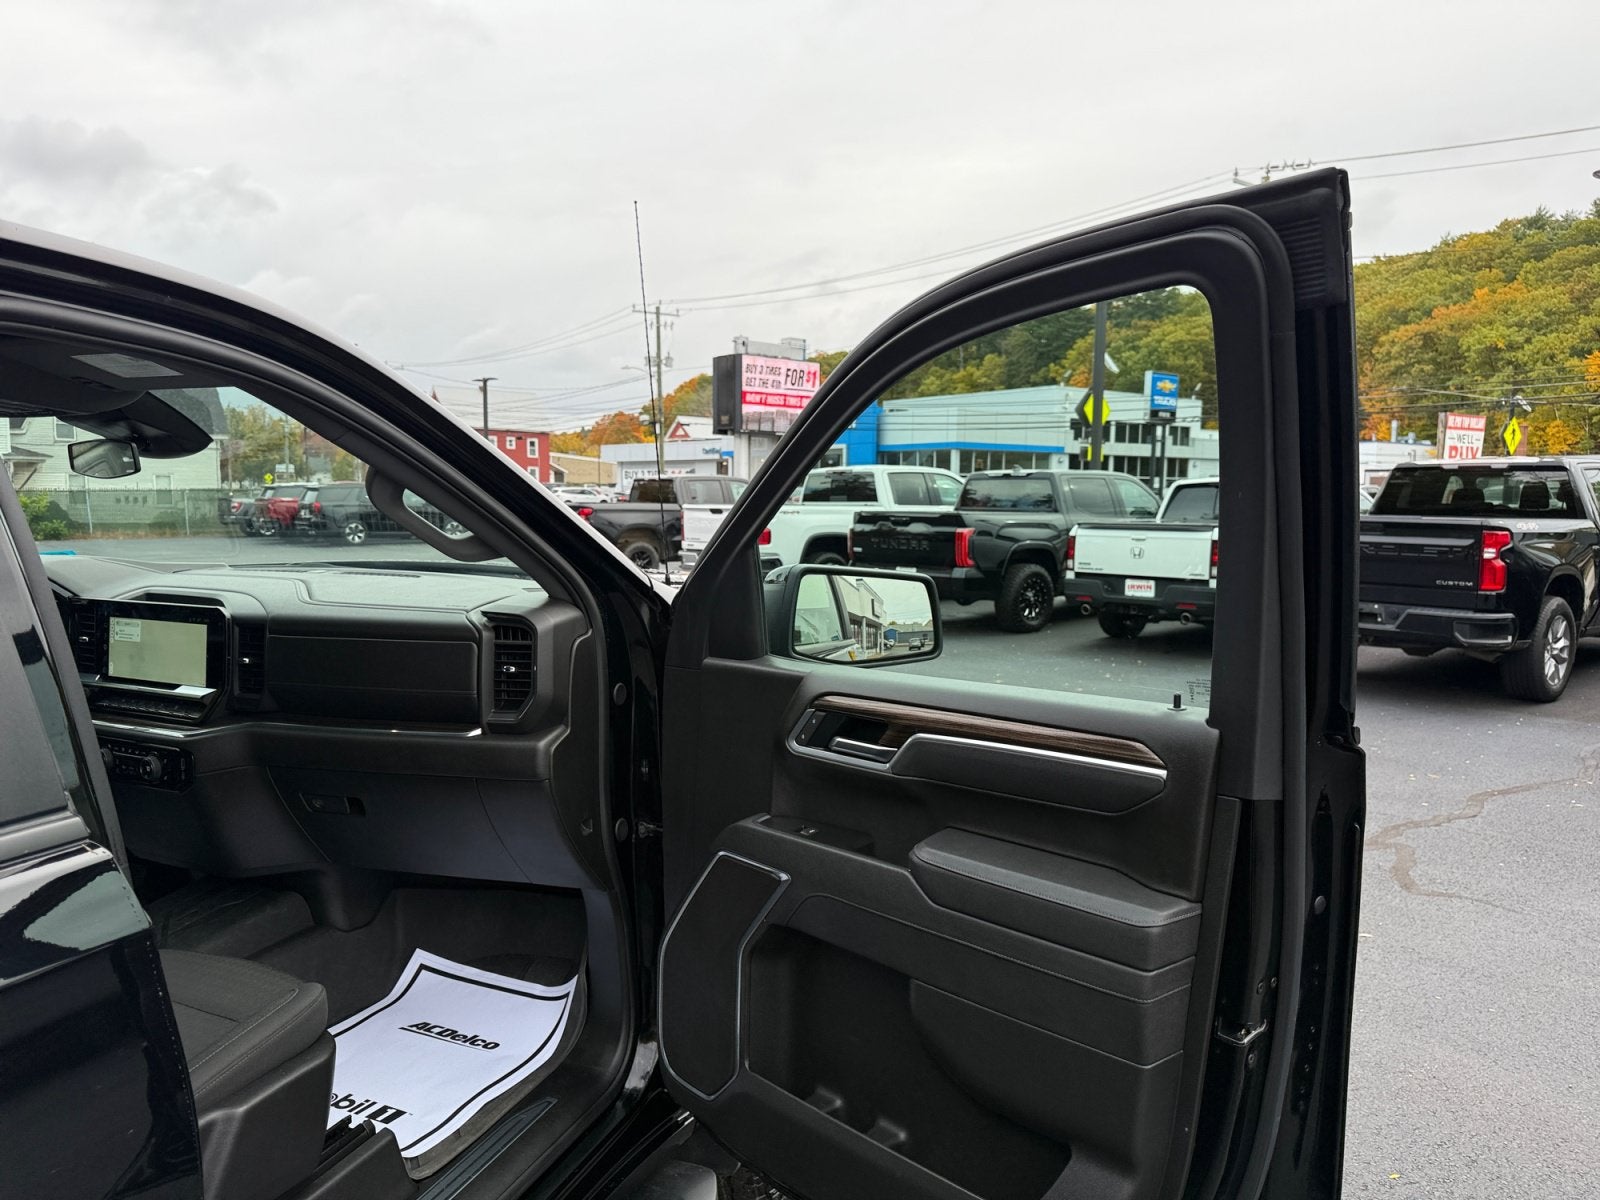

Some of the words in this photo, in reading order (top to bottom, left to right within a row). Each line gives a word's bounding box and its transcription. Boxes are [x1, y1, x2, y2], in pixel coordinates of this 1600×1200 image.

[745, 363, 758, 375] BUY
[765, 366, 782, 377] TIRES
[745, 376, 757, 387] GET
[758, 378, 769, 389] THE
[784, 368, 805, 388] FOR
[805, 370, 817, 388] $1
[1456, 433, 1474, 445] WE'LL
[871, 538, 930, 550] TUNDRA
[1436, 579, 1474, 587] CUSTOM
[407, 1021, 500, 1050] ACDelco
[330, 1092, 378, 1115] bil
